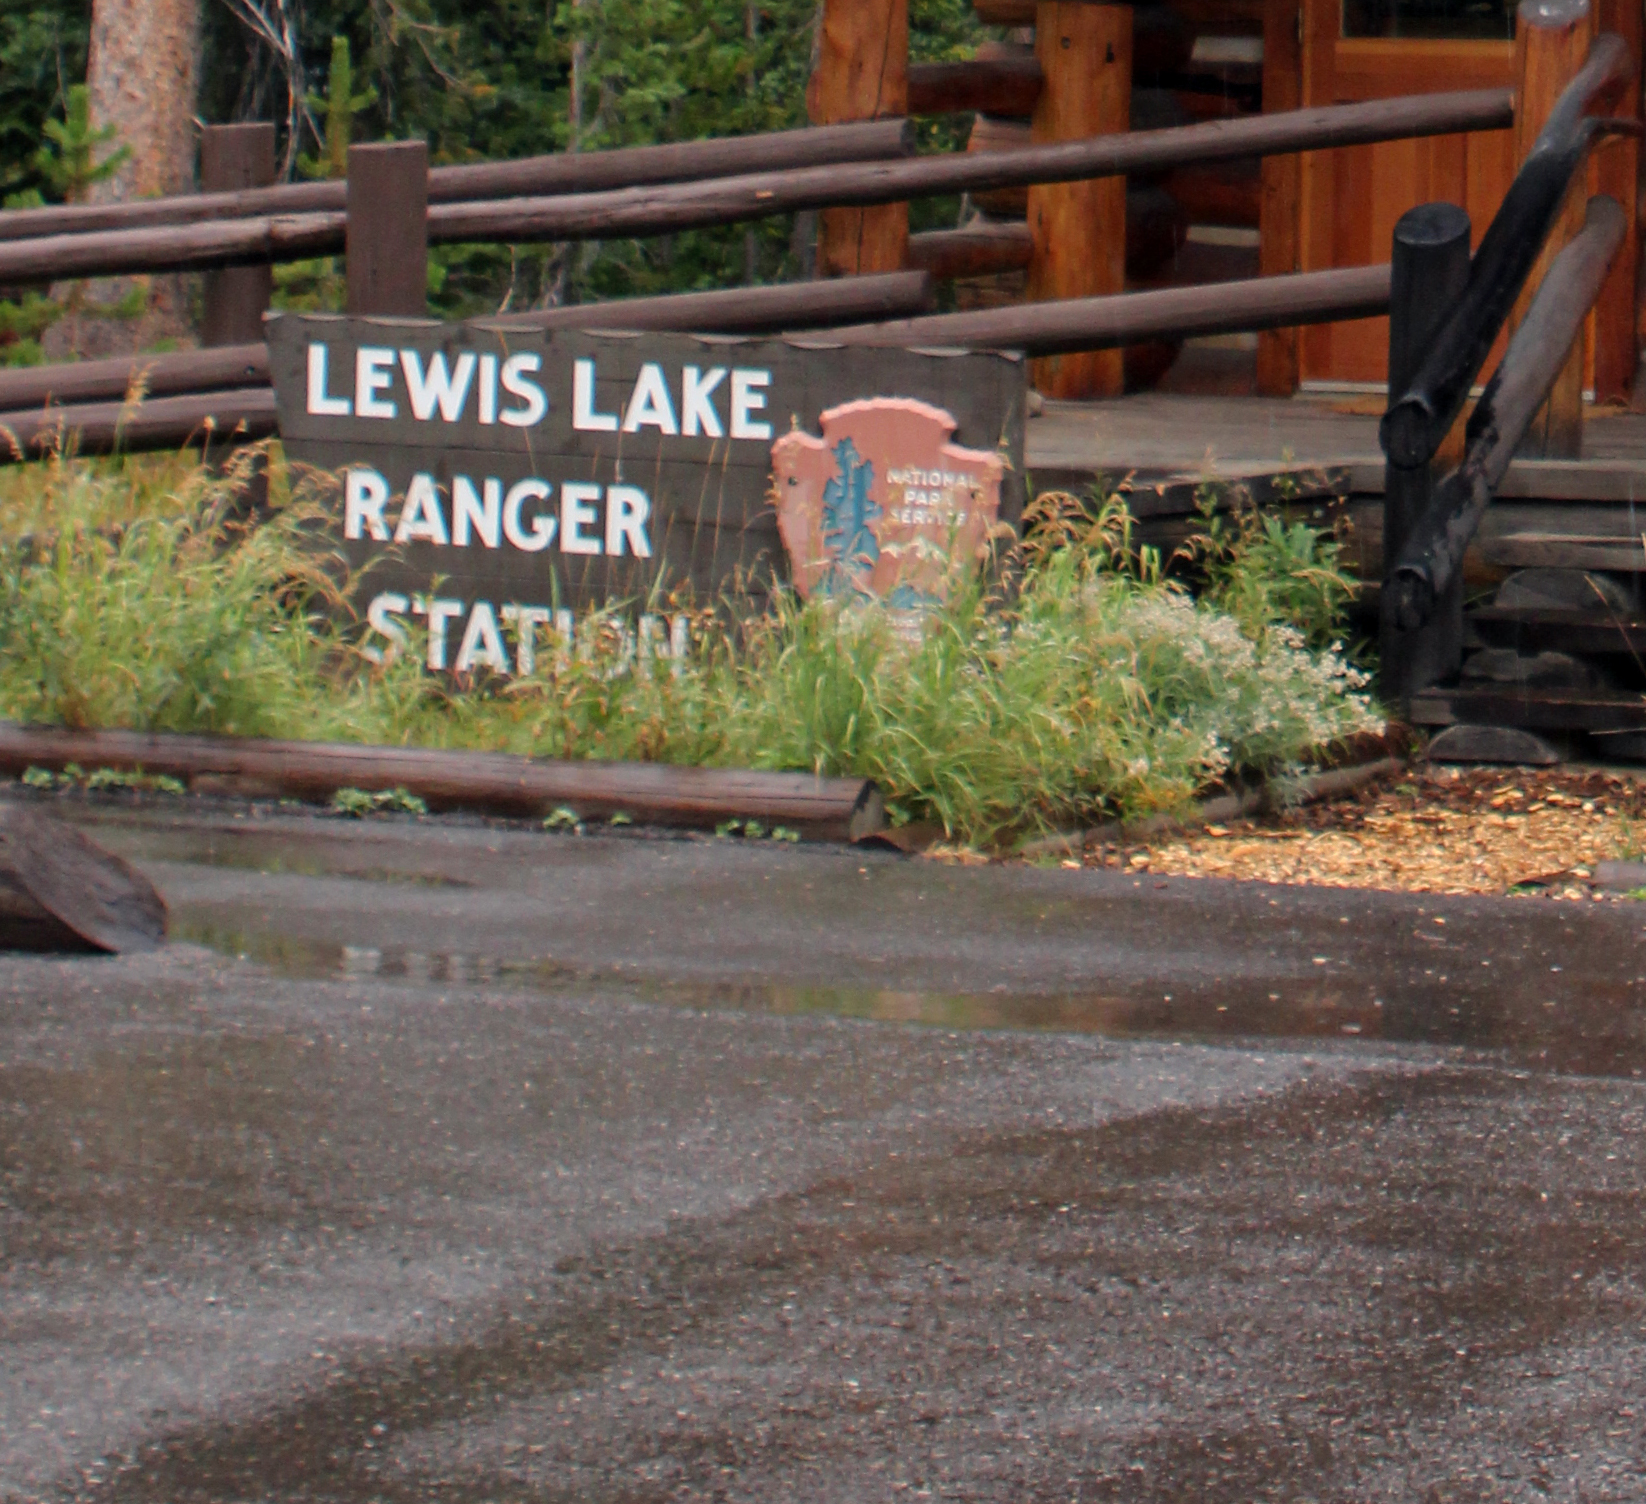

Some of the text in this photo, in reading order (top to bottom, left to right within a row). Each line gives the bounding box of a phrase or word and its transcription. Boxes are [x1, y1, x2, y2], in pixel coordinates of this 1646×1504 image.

[306, 343, 772, 440] LEWIS LAKE
[343, 469, 651, 558] RANGER
[886, 468, 981, 489] NATIONAL
